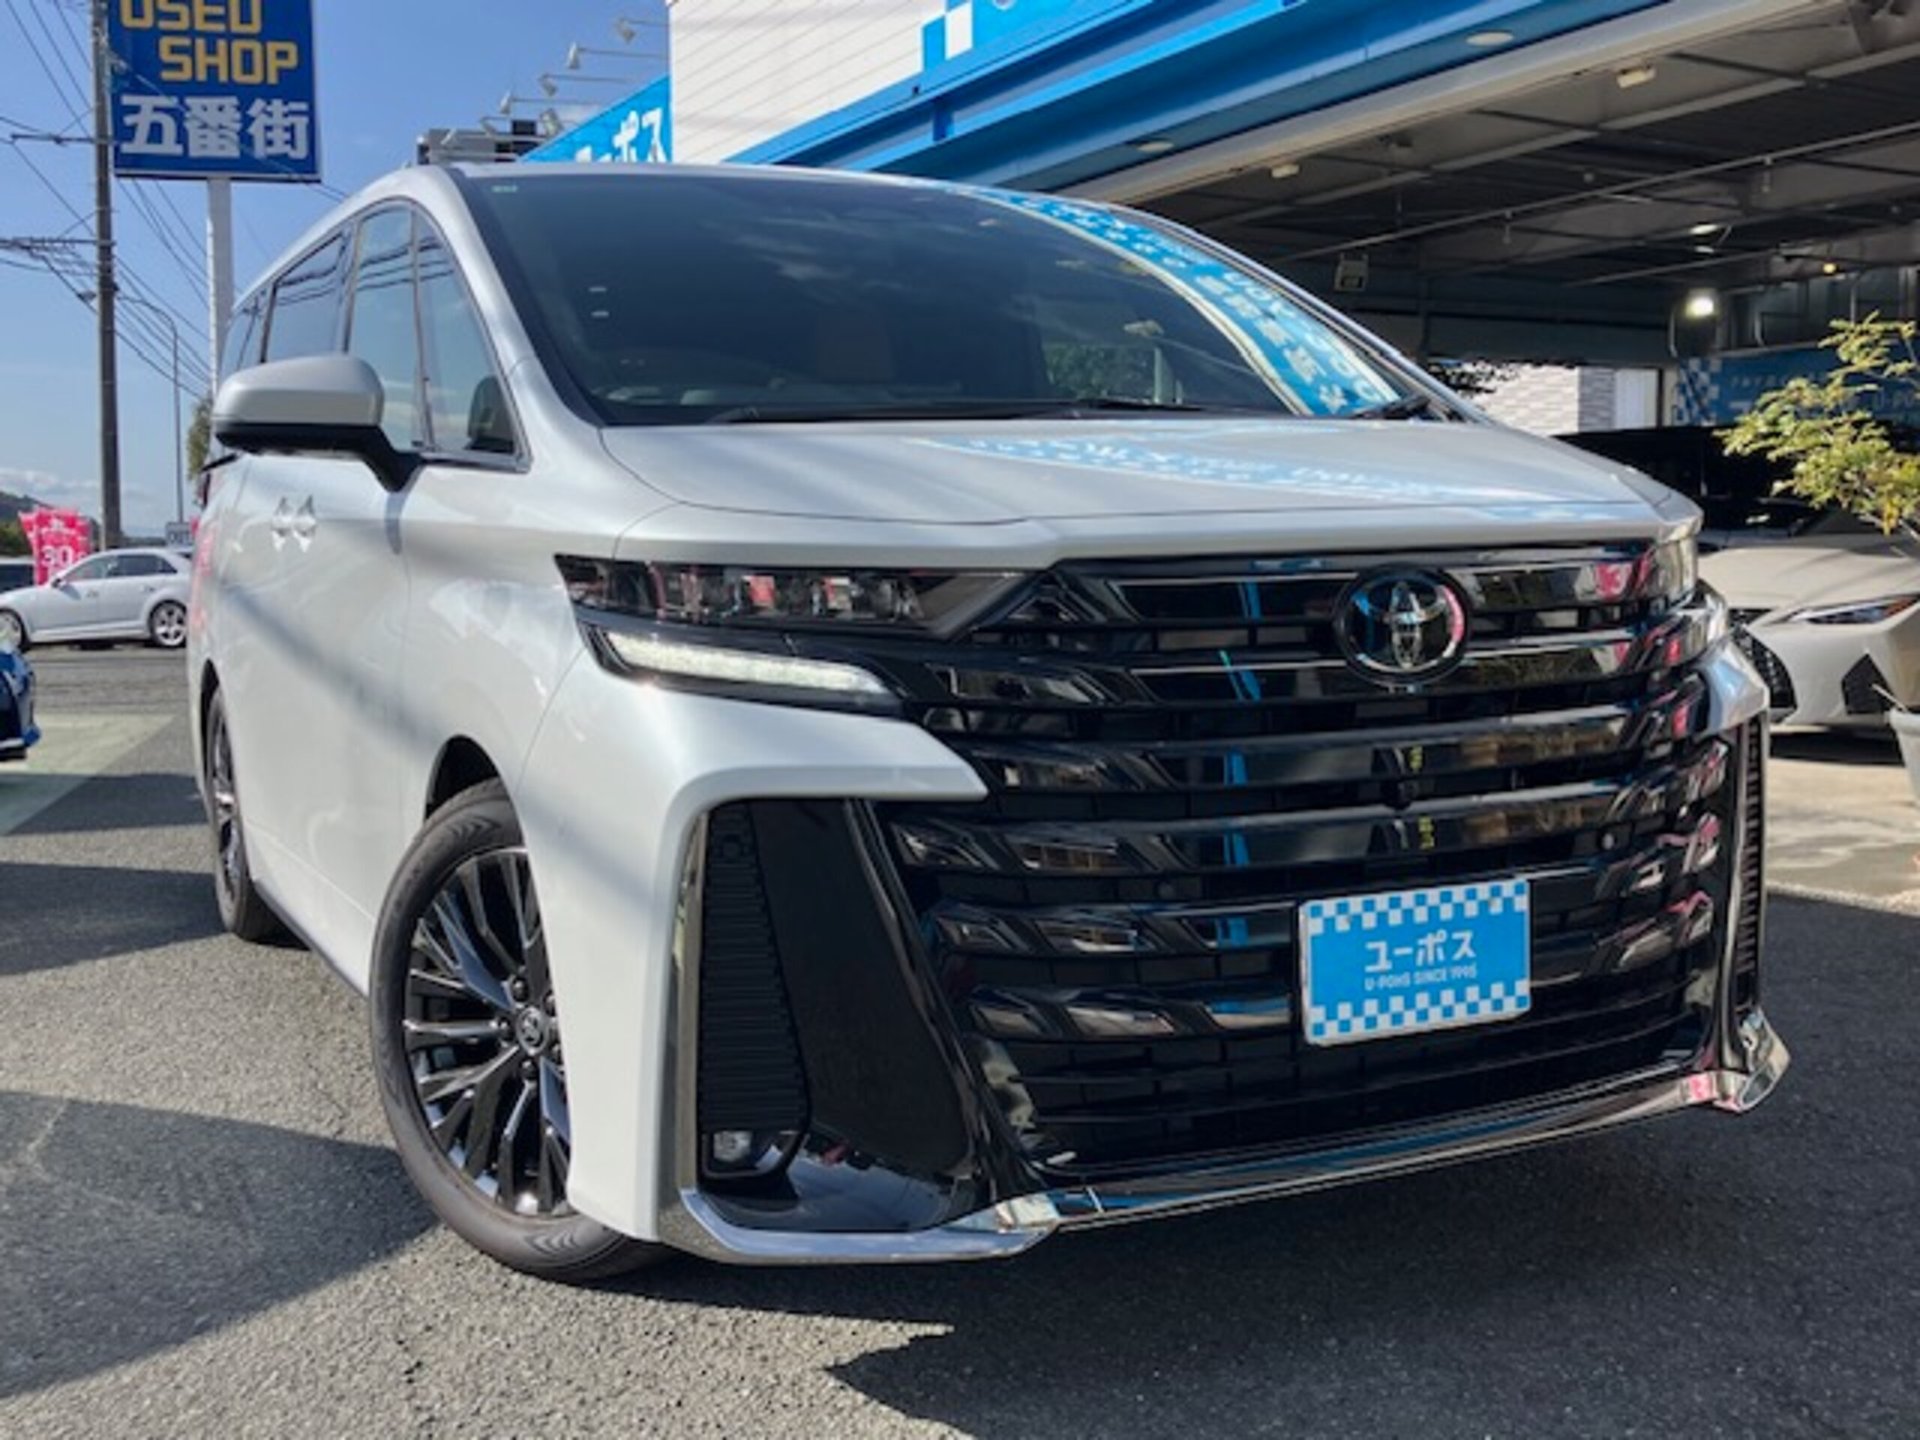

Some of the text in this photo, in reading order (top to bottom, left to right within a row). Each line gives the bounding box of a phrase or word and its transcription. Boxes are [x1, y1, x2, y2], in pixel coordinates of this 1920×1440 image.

[159, 36, 298, 84] SHOP
[120, 94, 309, 160] 五番街
[1364, 929, 1477, 973] ユーポス
